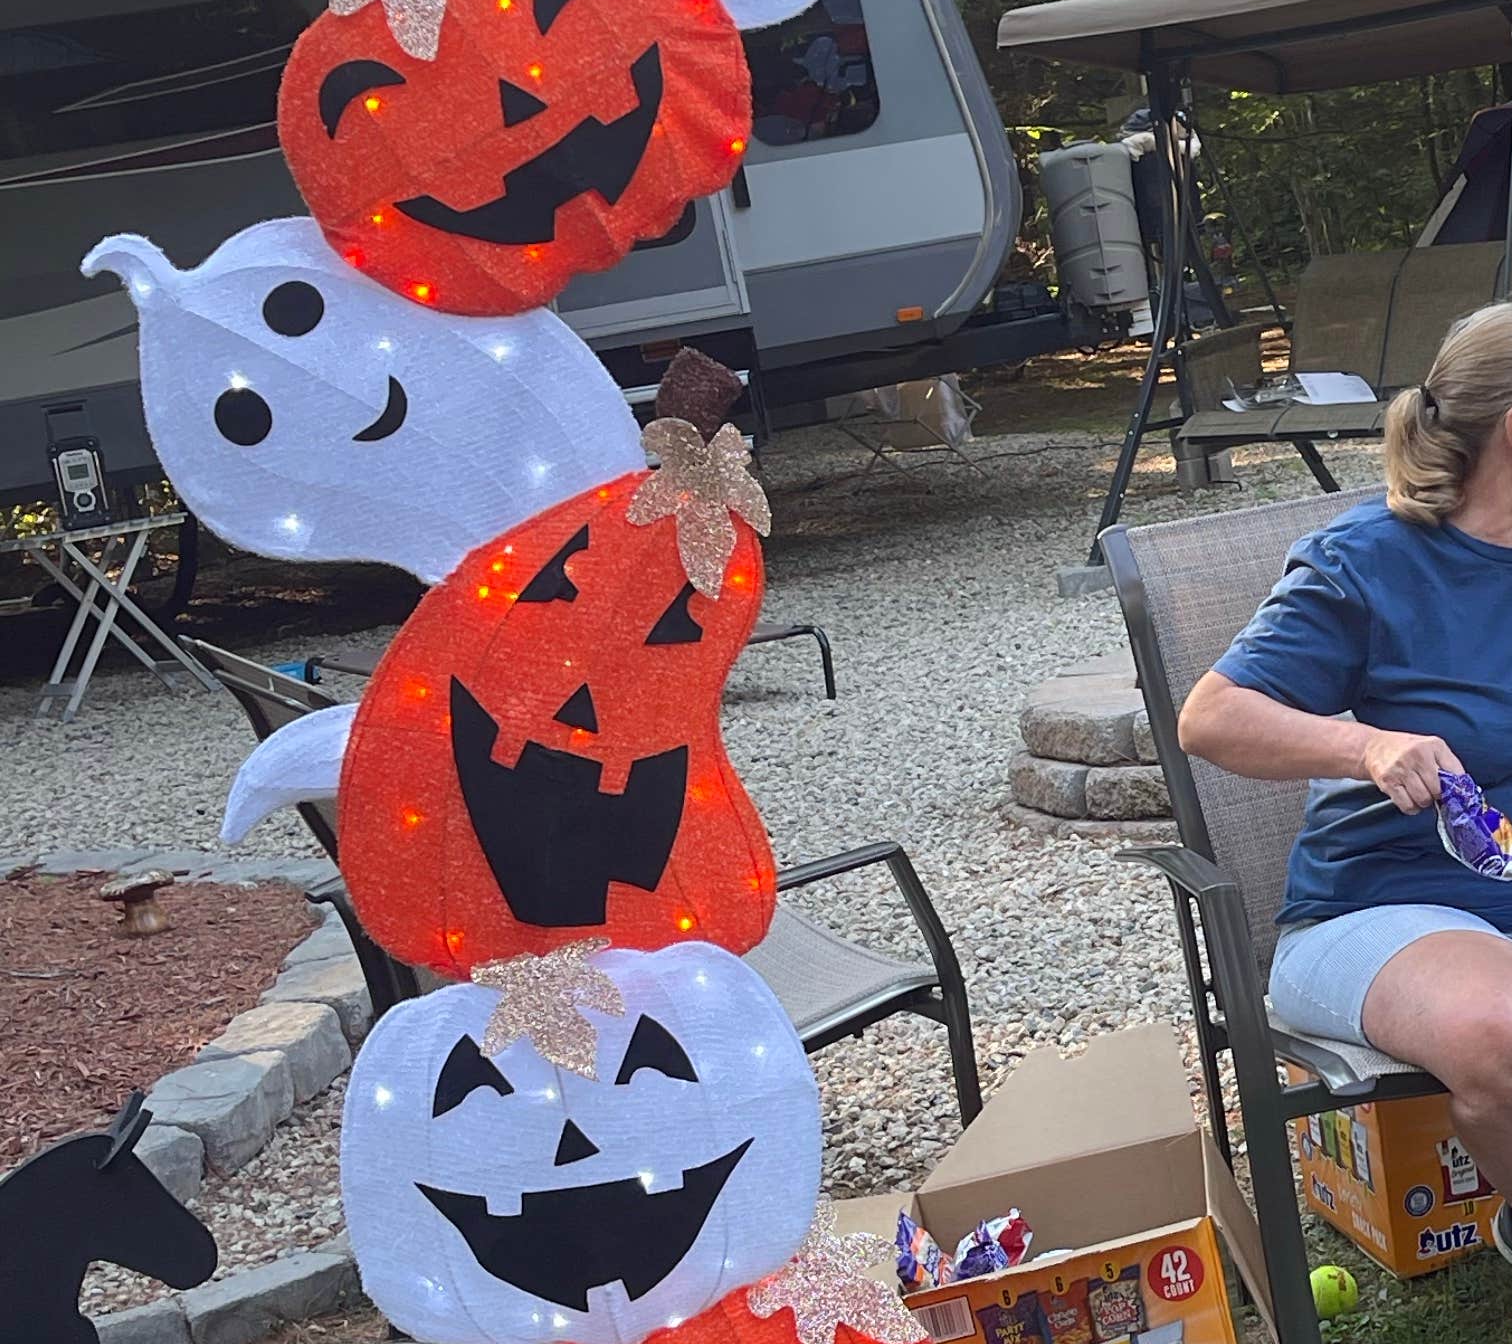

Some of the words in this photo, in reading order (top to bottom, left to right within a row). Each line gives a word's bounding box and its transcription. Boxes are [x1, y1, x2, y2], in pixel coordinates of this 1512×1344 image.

[1452, 1155, 1471, 1168] utz
[1436, 1223, 1478, 1253] utz
[1105, 1262, 1115, 1279] 5
[1160, 1249, 1192, 1284] 42
[1054, 1276, 1064, 1293] 6
[1163, 1279, 1197, 1299] COUNT
[1002, 1289, 1012, 1306] 6
[995, 1321, 1025, 1338] PARTY
